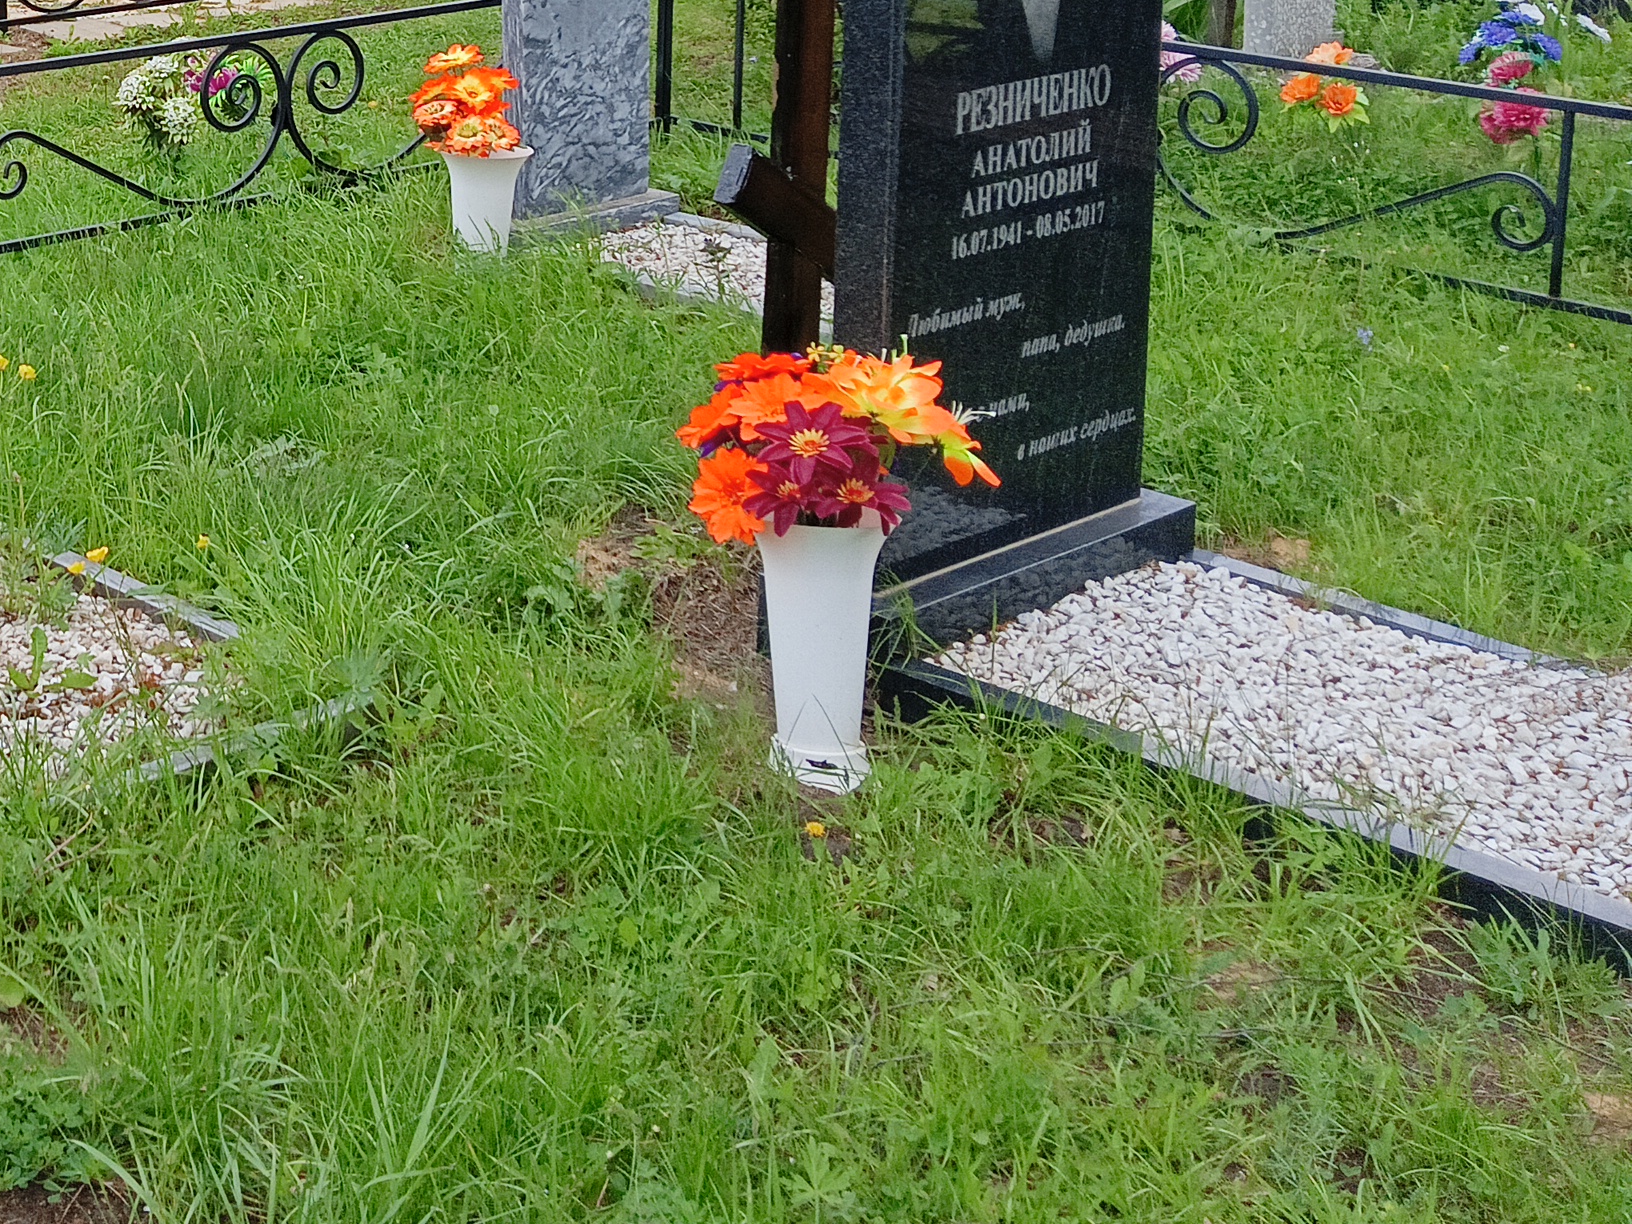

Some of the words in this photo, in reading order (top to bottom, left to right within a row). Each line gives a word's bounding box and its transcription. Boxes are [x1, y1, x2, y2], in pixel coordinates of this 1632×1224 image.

[954, 63, 1112, 135] РЕЗНИЧЕНКО
[971, 118, 1092, 178] АНАТОЛИЙ
[961, 159, 1099, 219] АНТОНОВИЧ
[952, 221, 1023, 260] 16.07.1941
[1036, 200, 1106, 239] 08.05.2017
[908, 296, 984, 338] Любимый
[986, 292, 1026, 322] муж,
[1021, 333, 1061, 359] папа,
[1029, 426, 1078, 457] наших
[1080, 407, 1137, 442] сердцах.
